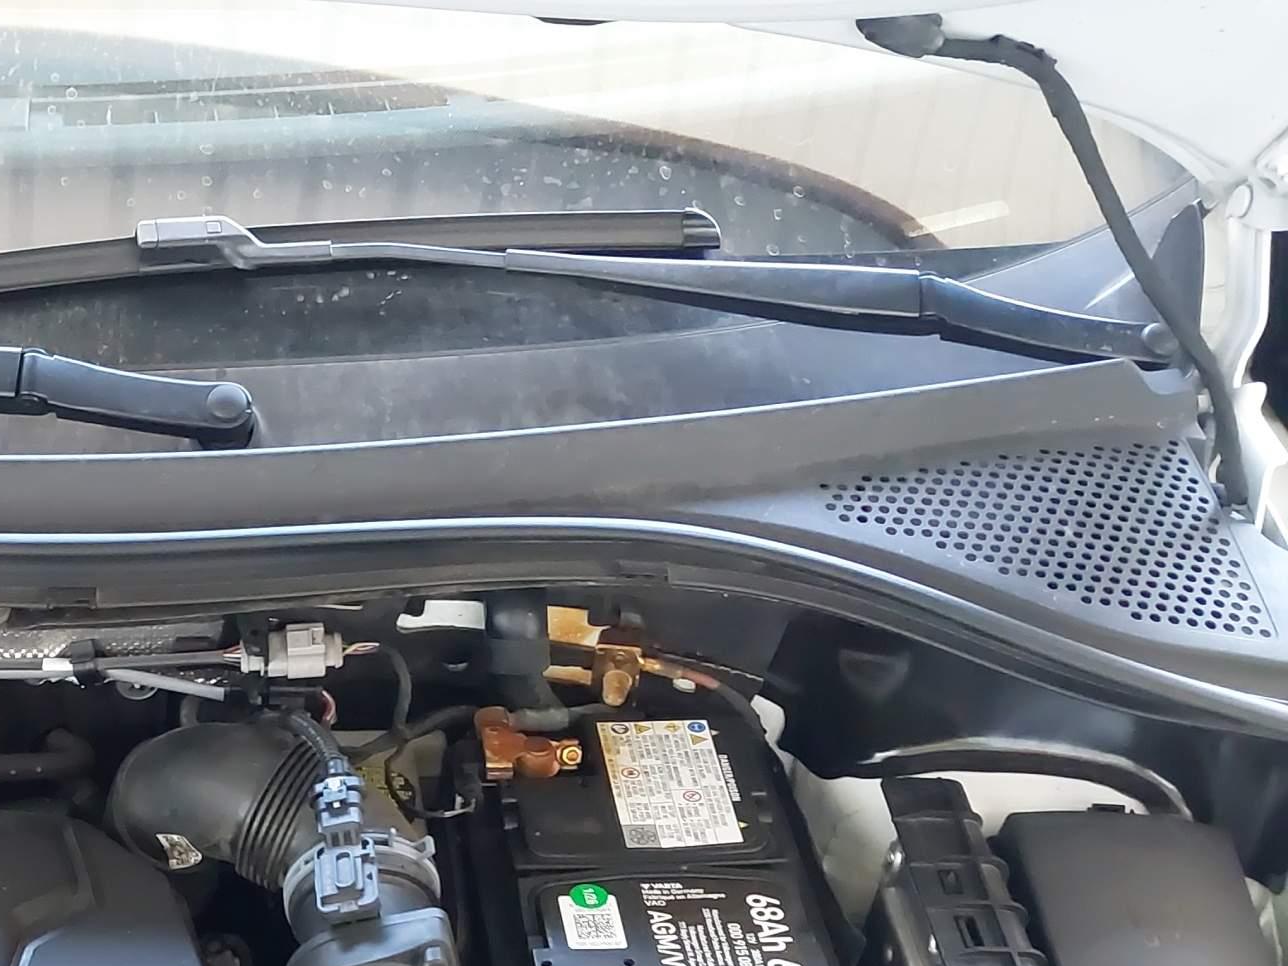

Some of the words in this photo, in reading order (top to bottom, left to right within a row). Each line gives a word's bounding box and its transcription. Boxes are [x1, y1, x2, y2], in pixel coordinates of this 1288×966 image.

[727, 923, 744, 939] 000
[746, 894, 793, 952] 68Ah
[733, 940, 750, 956] 915
